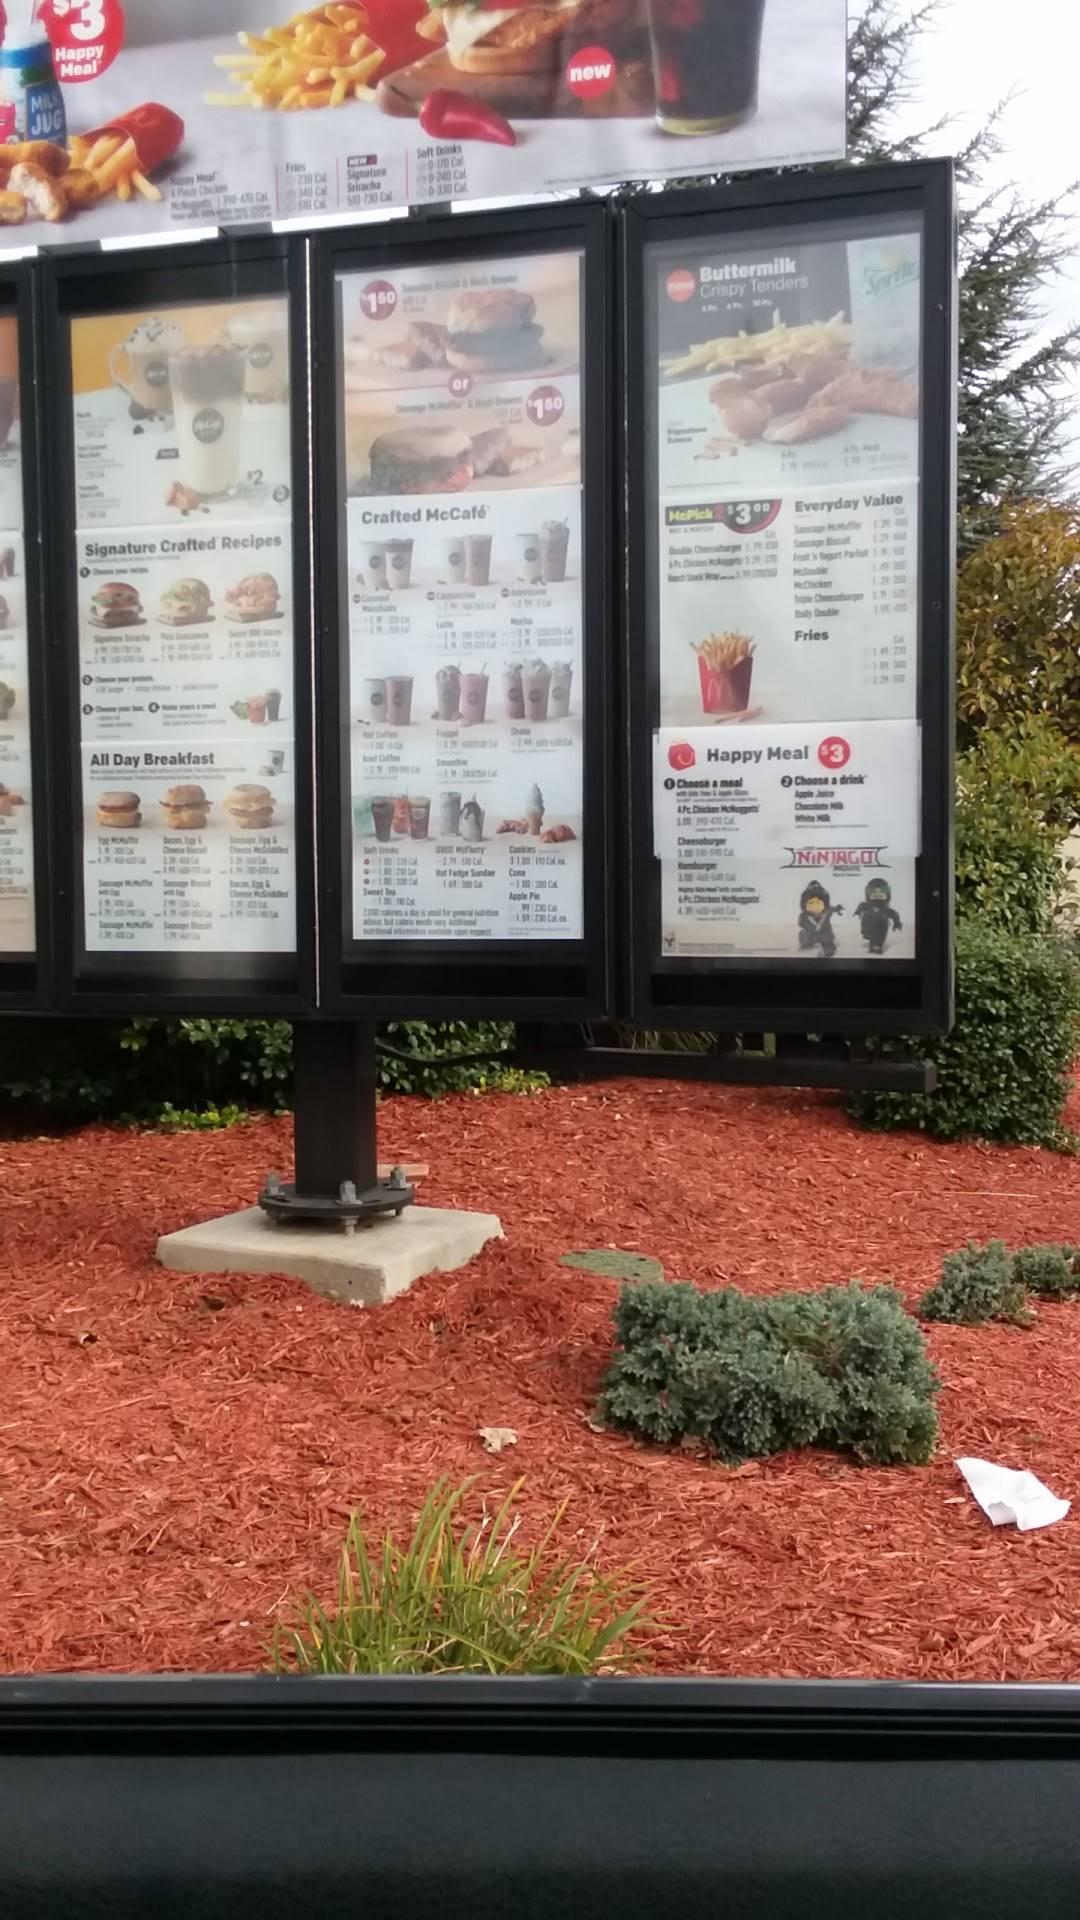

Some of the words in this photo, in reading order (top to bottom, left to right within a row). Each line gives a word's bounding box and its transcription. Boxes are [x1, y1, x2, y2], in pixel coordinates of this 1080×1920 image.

[55, 45, 104, 62] Happy
[60, 60, 97, 77] Meal
[569, 64, 612, 82] new
[31, 109, 63, 136] JUG
[416, 147, 434, 158] Soft
[436, 144, 463, 155] Drinks
[349, 157, 368, 166] NEW
[285, 163, 306, 173] Fries
[347, 168, 387, 180] Signature
[170, 176, 195, 185] Happy
[347, 181, 381, 192] Sriracha
[700, 257, 797, 282] Buttermilk
[667, 280, 695, 292] new
[700, 281, 746, 299] Crispy
[750, 275, 809, 294] Tenders
[452, 379, 469, 391] or
[794, 498, 860, 513] Everyday
[863, 494, 904, 507] Value
[361, 508, 422, 524] Crafted
[426, 504, 487, 522] McCafé
[669, 508, 714, 521] McPick
[85, 541, 157, 558] Signature
[160, 536, 217, 553] Crafted
[222, 534, 282, 550] Recipes
[794, 629, 829, 642] Fries
[706, 748, 762, 764] Happy
[767, 745, 809, 760] Meal
[820, 743, 845, 763] $3
[90, 753, 110, 767] All
[113, 753, 141, 769] Day
[144, 751, 216, 766] Breakfast
[677, 778, 710, 789] Choose
[720, 776, 743, 788] meal
[794, 775, 829, 786] Choose
[840, 774, 865, 785] drink
[794, 790, 814, 799] Apple
[815, 790, 835, 798] Juice
[692, 805, 720, 814] Chicken
[794, 802, 829, 811] Chocolate
[830, 801, 844, 810] Milk
[794, 814, 816, 822] White
[816, 814, 831, 822] Milk
[677, 836, 728, 847] Cheeseburger
[508, 845, 536, 854] Cookies
[678, 861, 717, 871] Hamburger
[435, 869, 447, 877] Hot
[448, 869, 469, 878] Fudge
[470, 868, 496, 877] Sundae
[508, 869, 526, 877] Cone
[363, 888, 384, 896] Sweet
[508, 892, 528, 902] Apple
[529, 891, 541, 900] Pie
